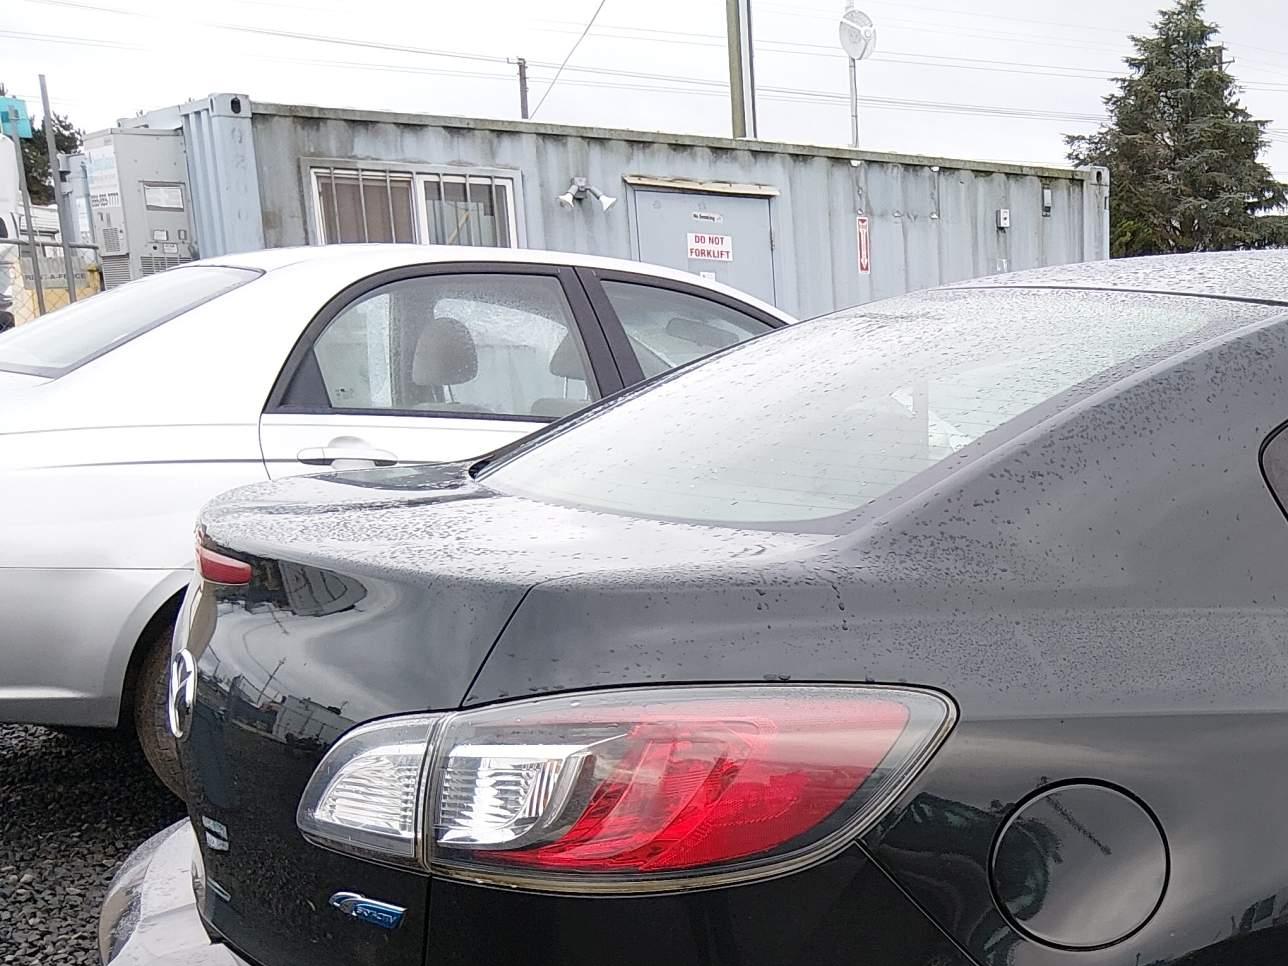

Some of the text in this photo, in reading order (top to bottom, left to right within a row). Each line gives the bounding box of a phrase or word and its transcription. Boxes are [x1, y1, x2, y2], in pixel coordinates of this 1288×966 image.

[694, 235, 725, 245] DO NOT
[689, 247, 730, 259] FORKLIFT
